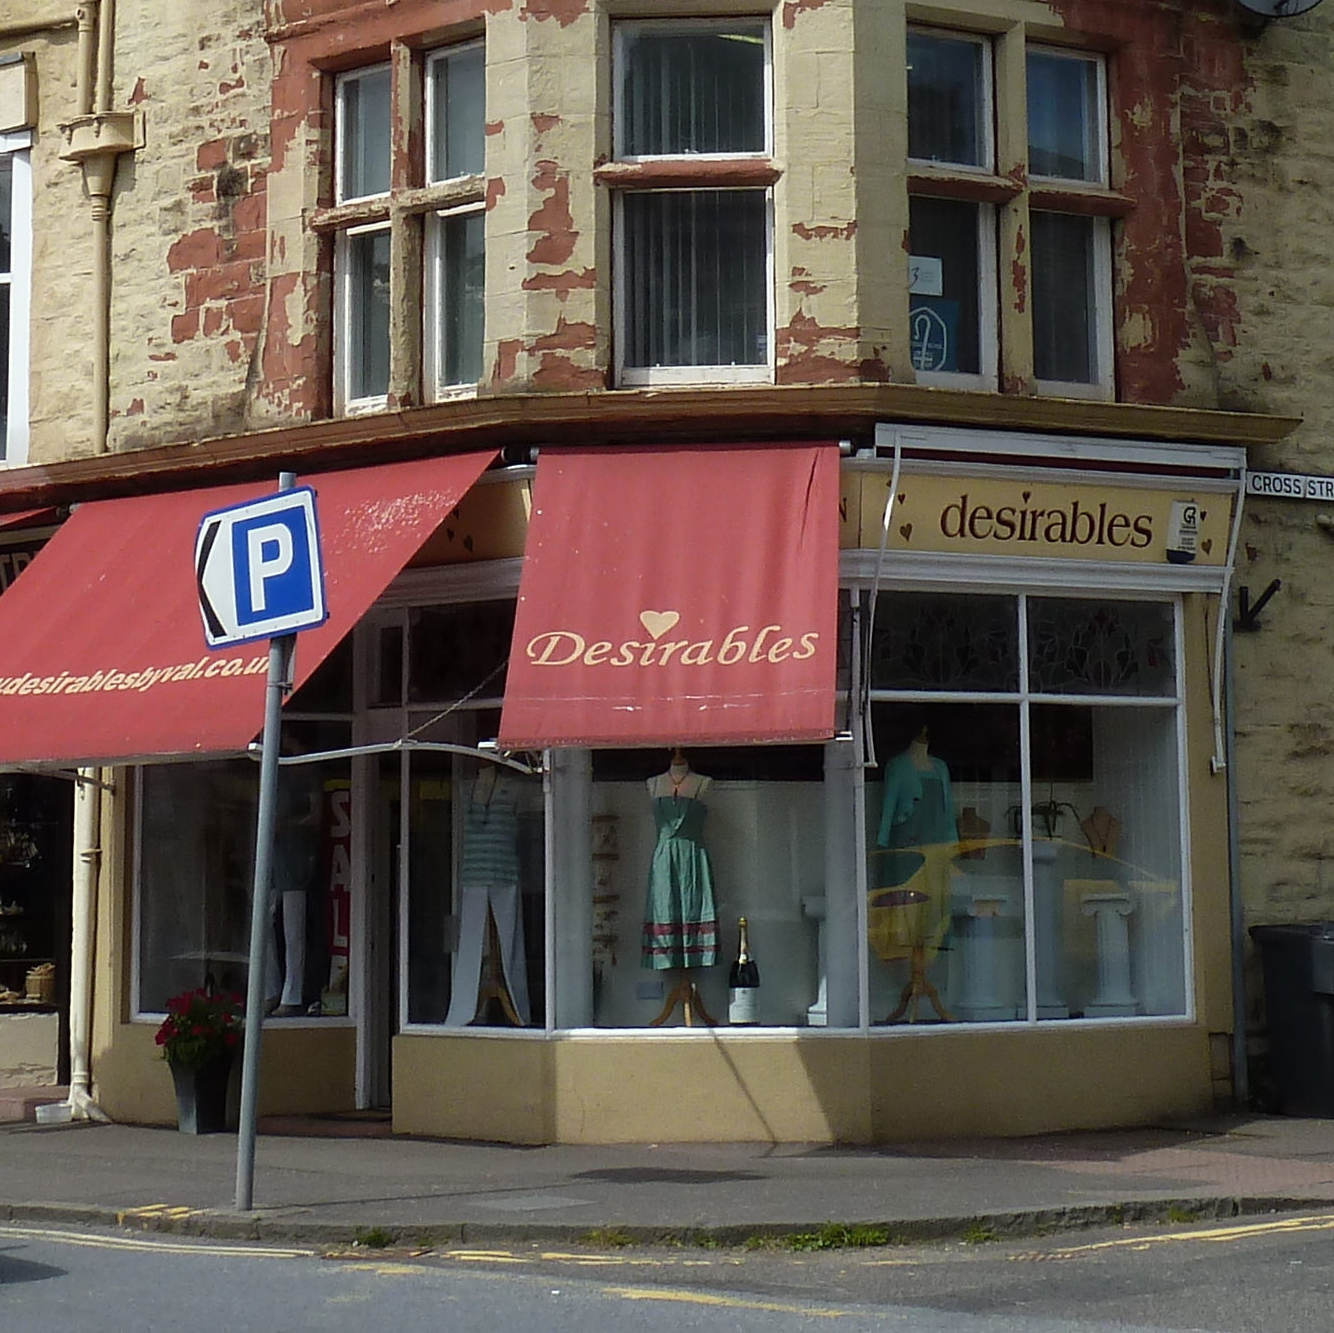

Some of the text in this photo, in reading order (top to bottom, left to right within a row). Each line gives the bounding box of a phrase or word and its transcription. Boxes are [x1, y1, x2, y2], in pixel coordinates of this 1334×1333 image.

[1252, 474, 1301, 495] CROSS
[940, 491, 1153, 548] desirables
[248, 523, 294, 612] P
[526, 625, 819, 666] Desirables
